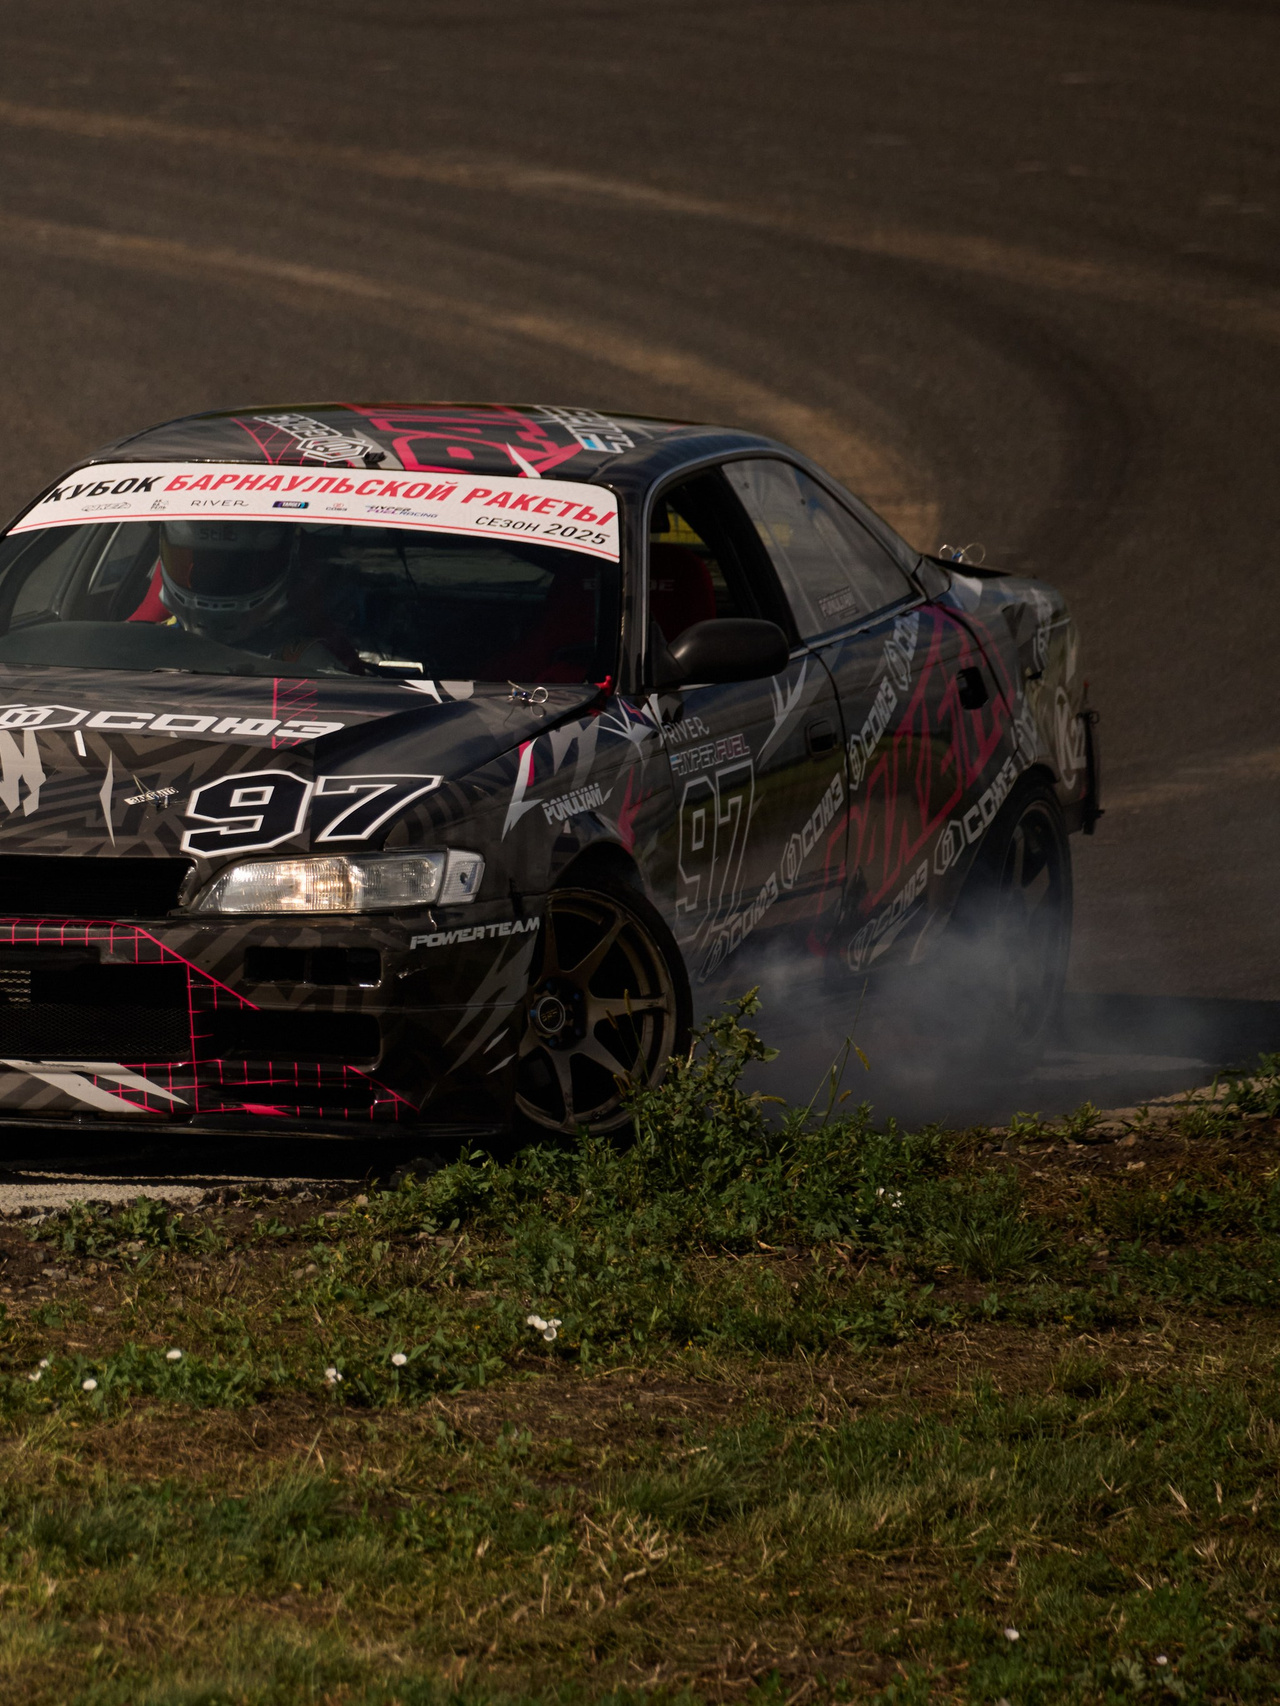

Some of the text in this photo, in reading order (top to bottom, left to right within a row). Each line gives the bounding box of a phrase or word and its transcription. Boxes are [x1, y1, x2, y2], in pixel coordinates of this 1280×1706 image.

[42, 474, 619, 526] КУБОК БАРНАУЛЬСКОЙ РАКЕТЫ
[475, 516, 611, 545] СЕЗОН 2025
[662, 716, 710, 744] RIVER
[670, 733, 751, 776] HYPERFUEL
[180, 769, 444, 859] 97
[673, 759, 755, 944] 97
